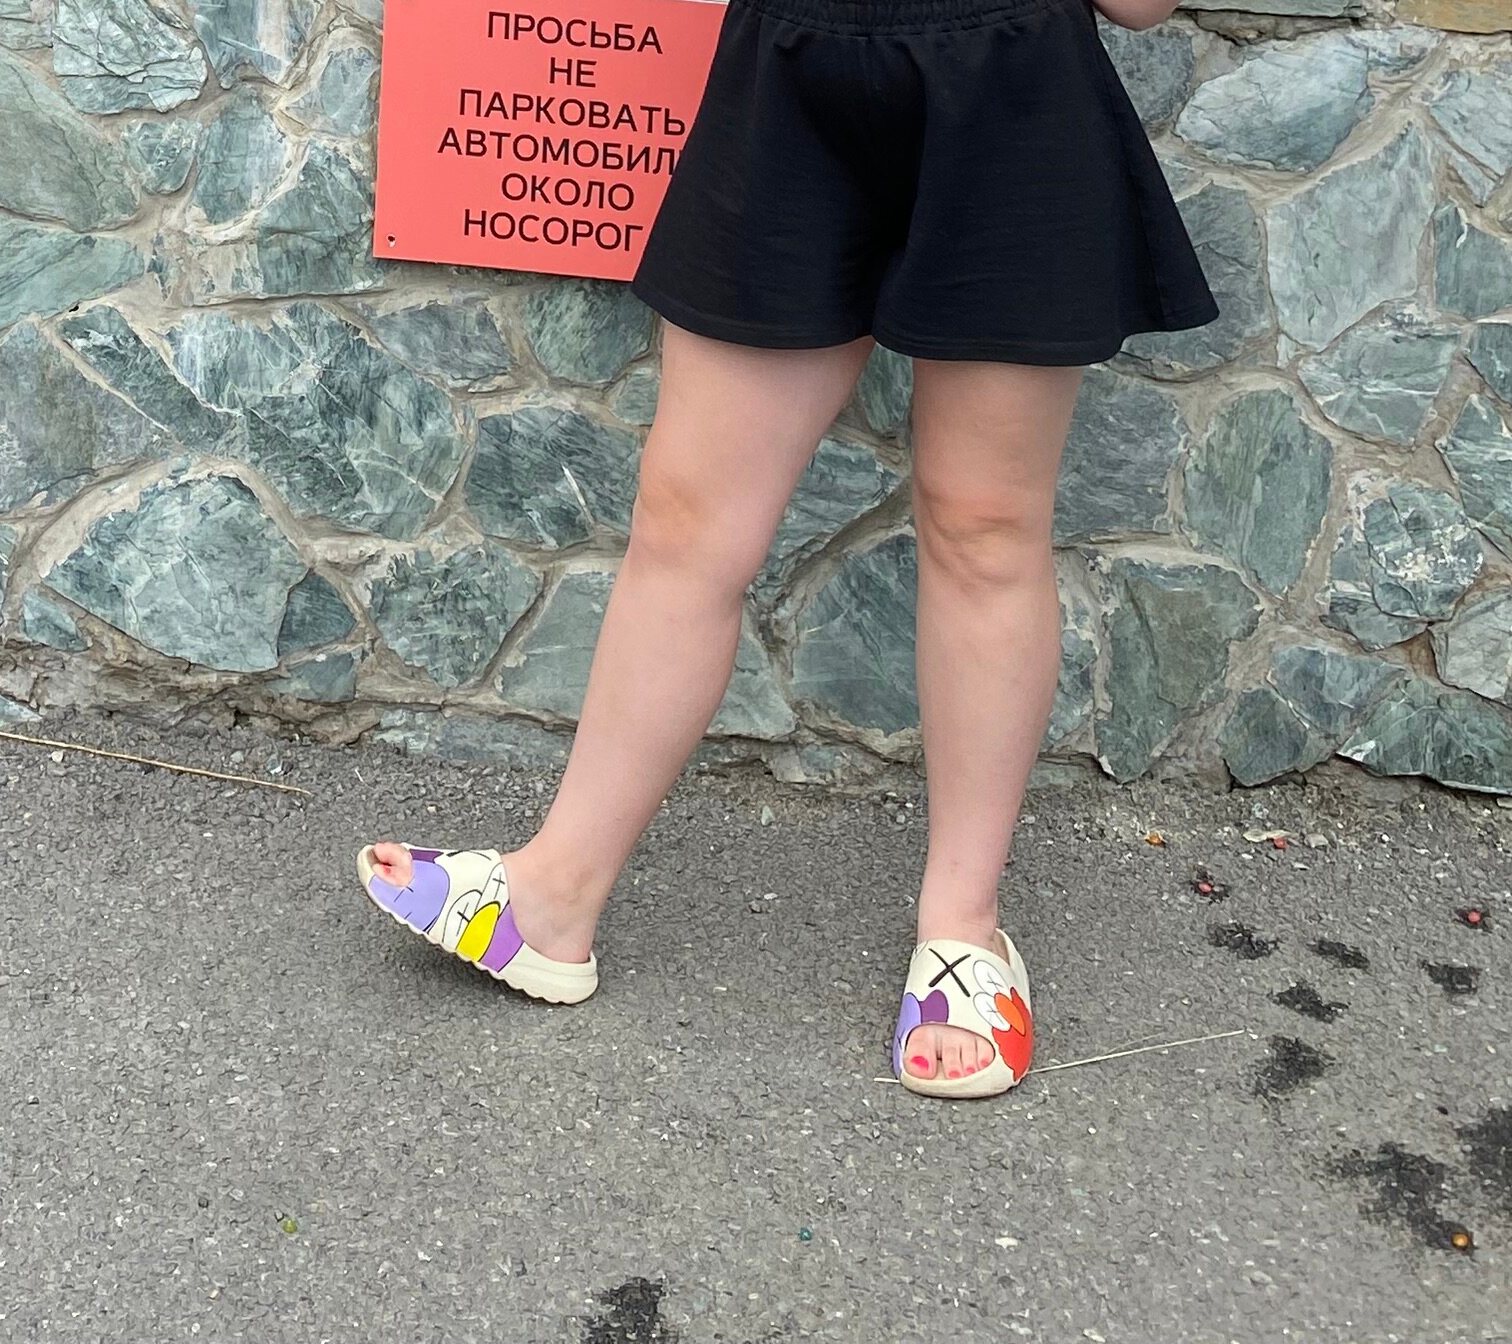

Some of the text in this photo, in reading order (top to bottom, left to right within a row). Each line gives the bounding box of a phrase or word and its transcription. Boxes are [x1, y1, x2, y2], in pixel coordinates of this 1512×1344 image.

[487, 11, 663, 55] ПРОСЬБА
[549, 56, 597, 88] НЕ
[459, 88, 686, 136] ПАРКОВАТЬ
[437, 127, 681, 176] АВТОМОБИЛ
[501, 173, 635, 212] ОКОЛО
[464, 208, 644, 252] НОСОРОГ
